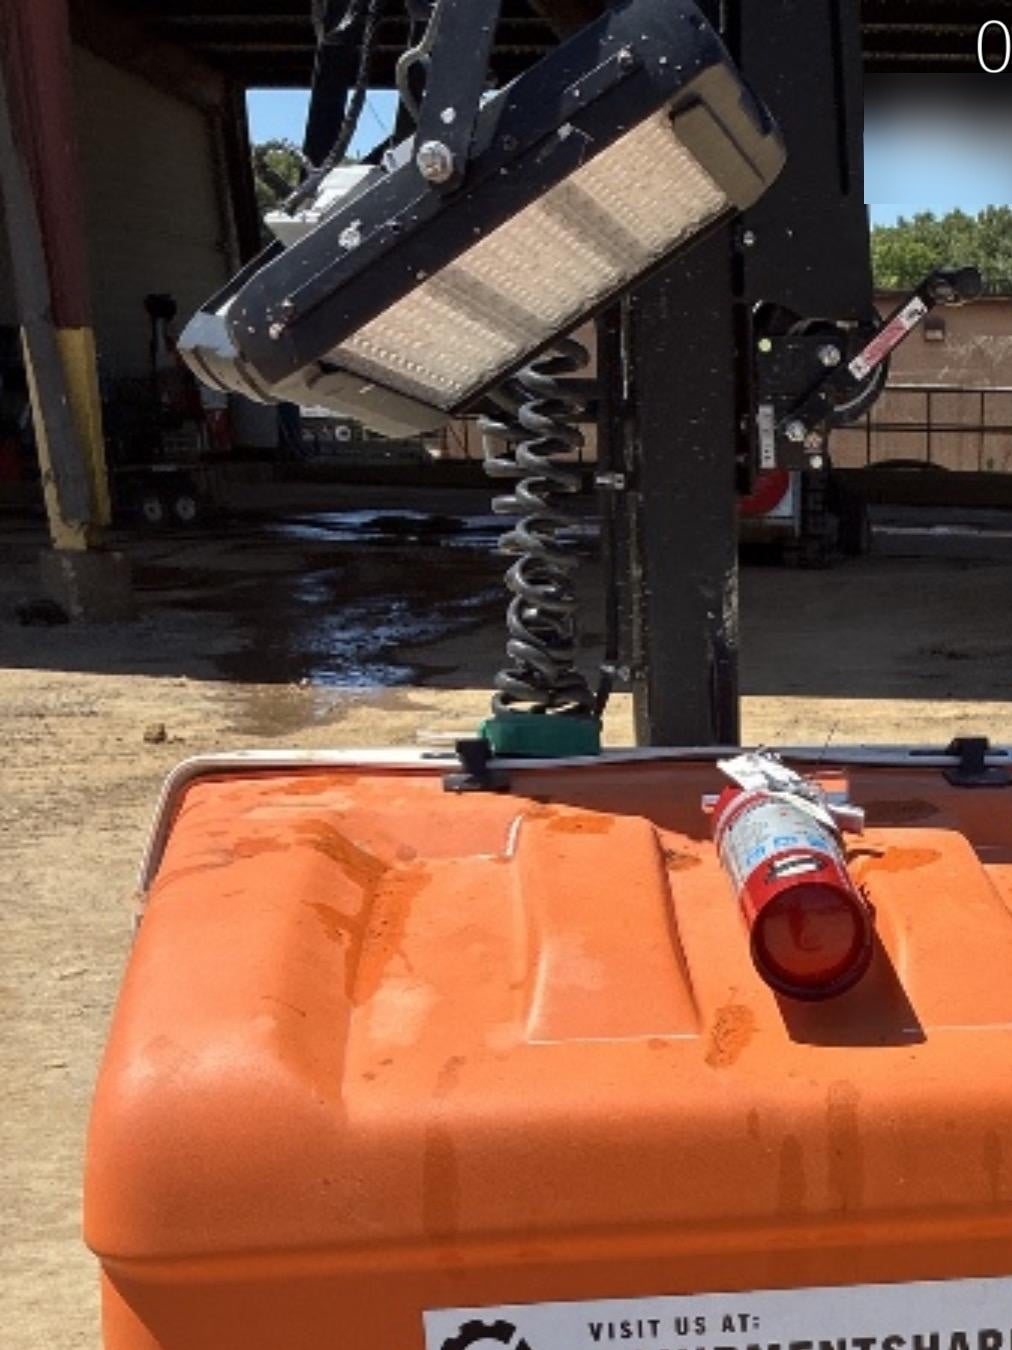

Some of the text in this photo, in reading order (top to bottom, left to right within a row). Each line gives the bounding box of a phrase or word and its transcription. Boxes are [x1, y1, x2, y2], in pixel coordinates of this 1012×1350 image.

[588, 1313, 761, 1342] VISIT US AT:
